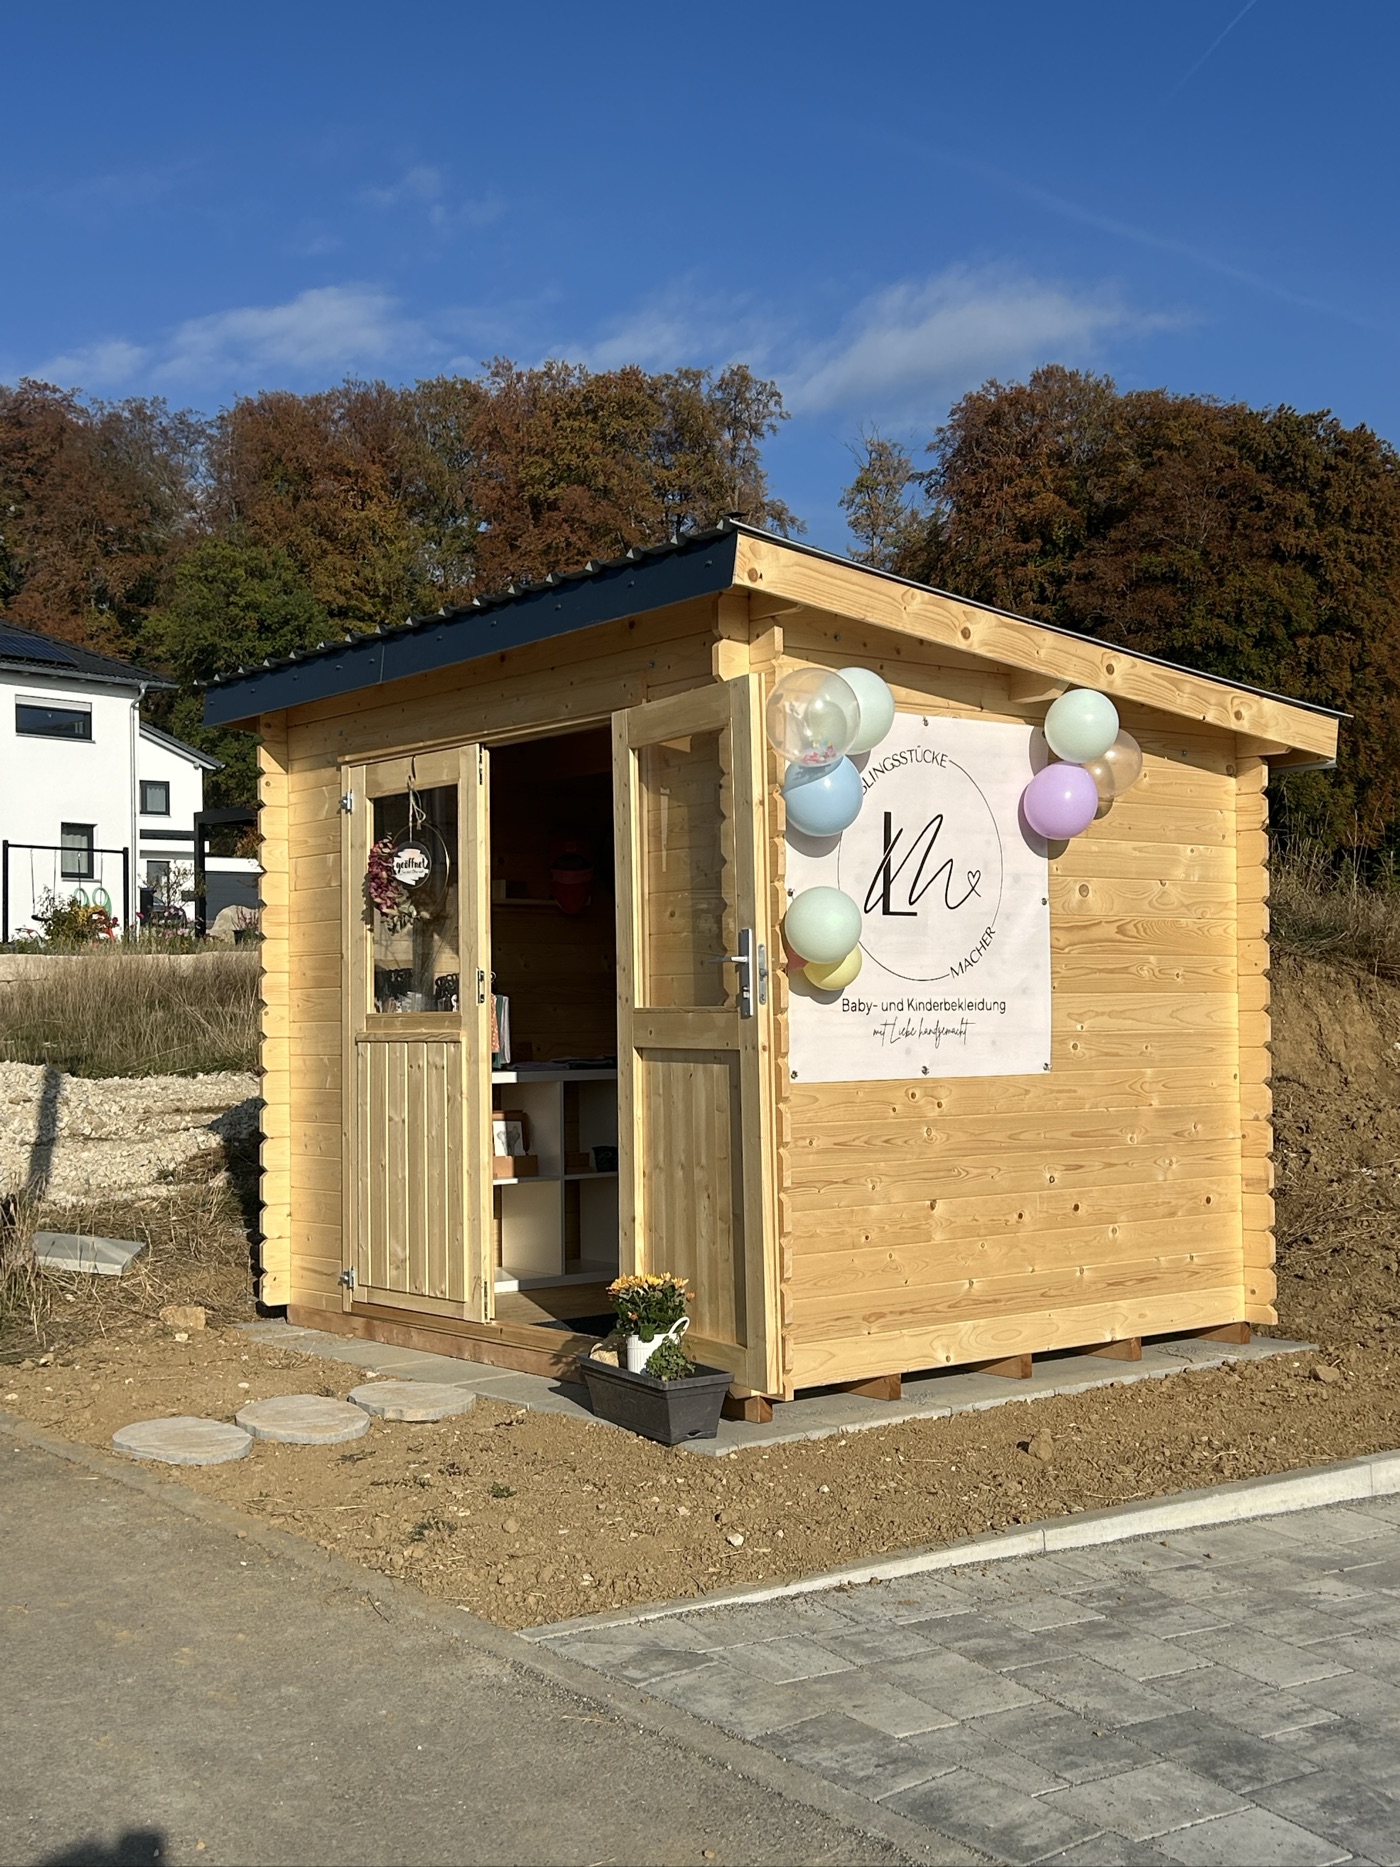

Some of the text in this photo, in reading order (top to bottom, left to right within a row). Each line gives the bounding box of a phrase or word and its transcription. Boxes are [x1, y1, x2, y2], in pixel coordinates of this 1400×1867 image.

[395, 857, 425, 874] geöffnet
[950, 926, 996, 979] MACHER
[842, 997, 1006, 1016] Baby- und Kinderbekleidung
[890, 1016, 916, 1044] Liebe
[918, 1016, 976, 1049] handgemacht
